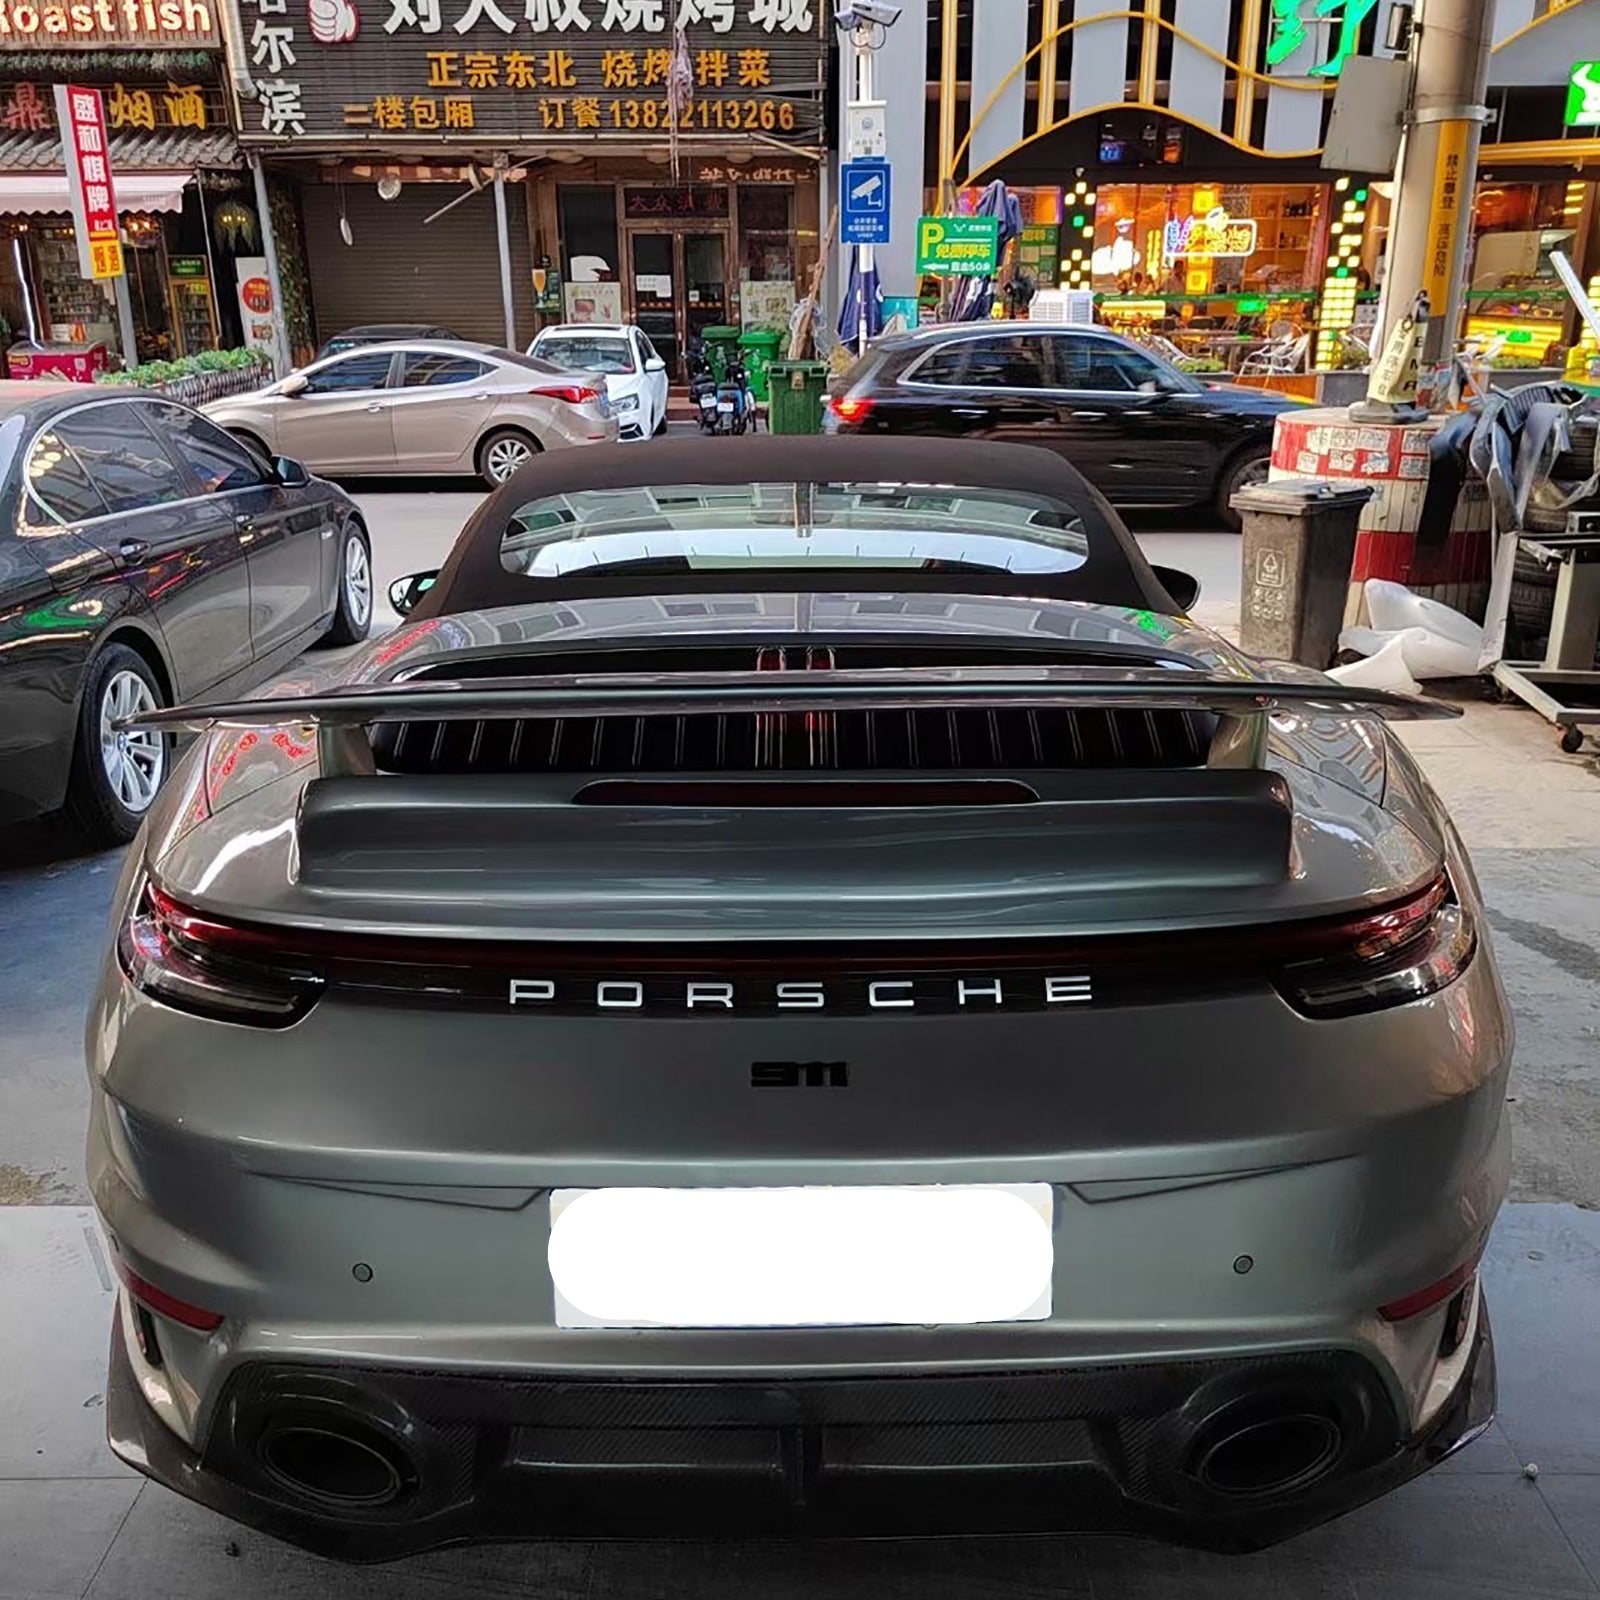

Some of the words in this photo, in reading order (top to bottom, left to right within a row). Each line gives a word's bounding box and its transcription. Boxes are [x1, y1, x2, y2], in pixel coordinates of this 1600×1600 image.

[122, 0, 211, 31] fish
[427, 50, 577, 89] 正宗东北
[696, 50, 771, 88] 拌菜
[109, 80, 206, 131] 烟酒
[343, 94, 475, 129] 二楼包厢
[539, 97, 601, 129] 订餐
[609, 100, 796, 130] 13822113266
[921, 223, 945, 258] P
[510, 976, 1092, 1008] PORSCHE
[751, 1061, 848, 1087] 911
